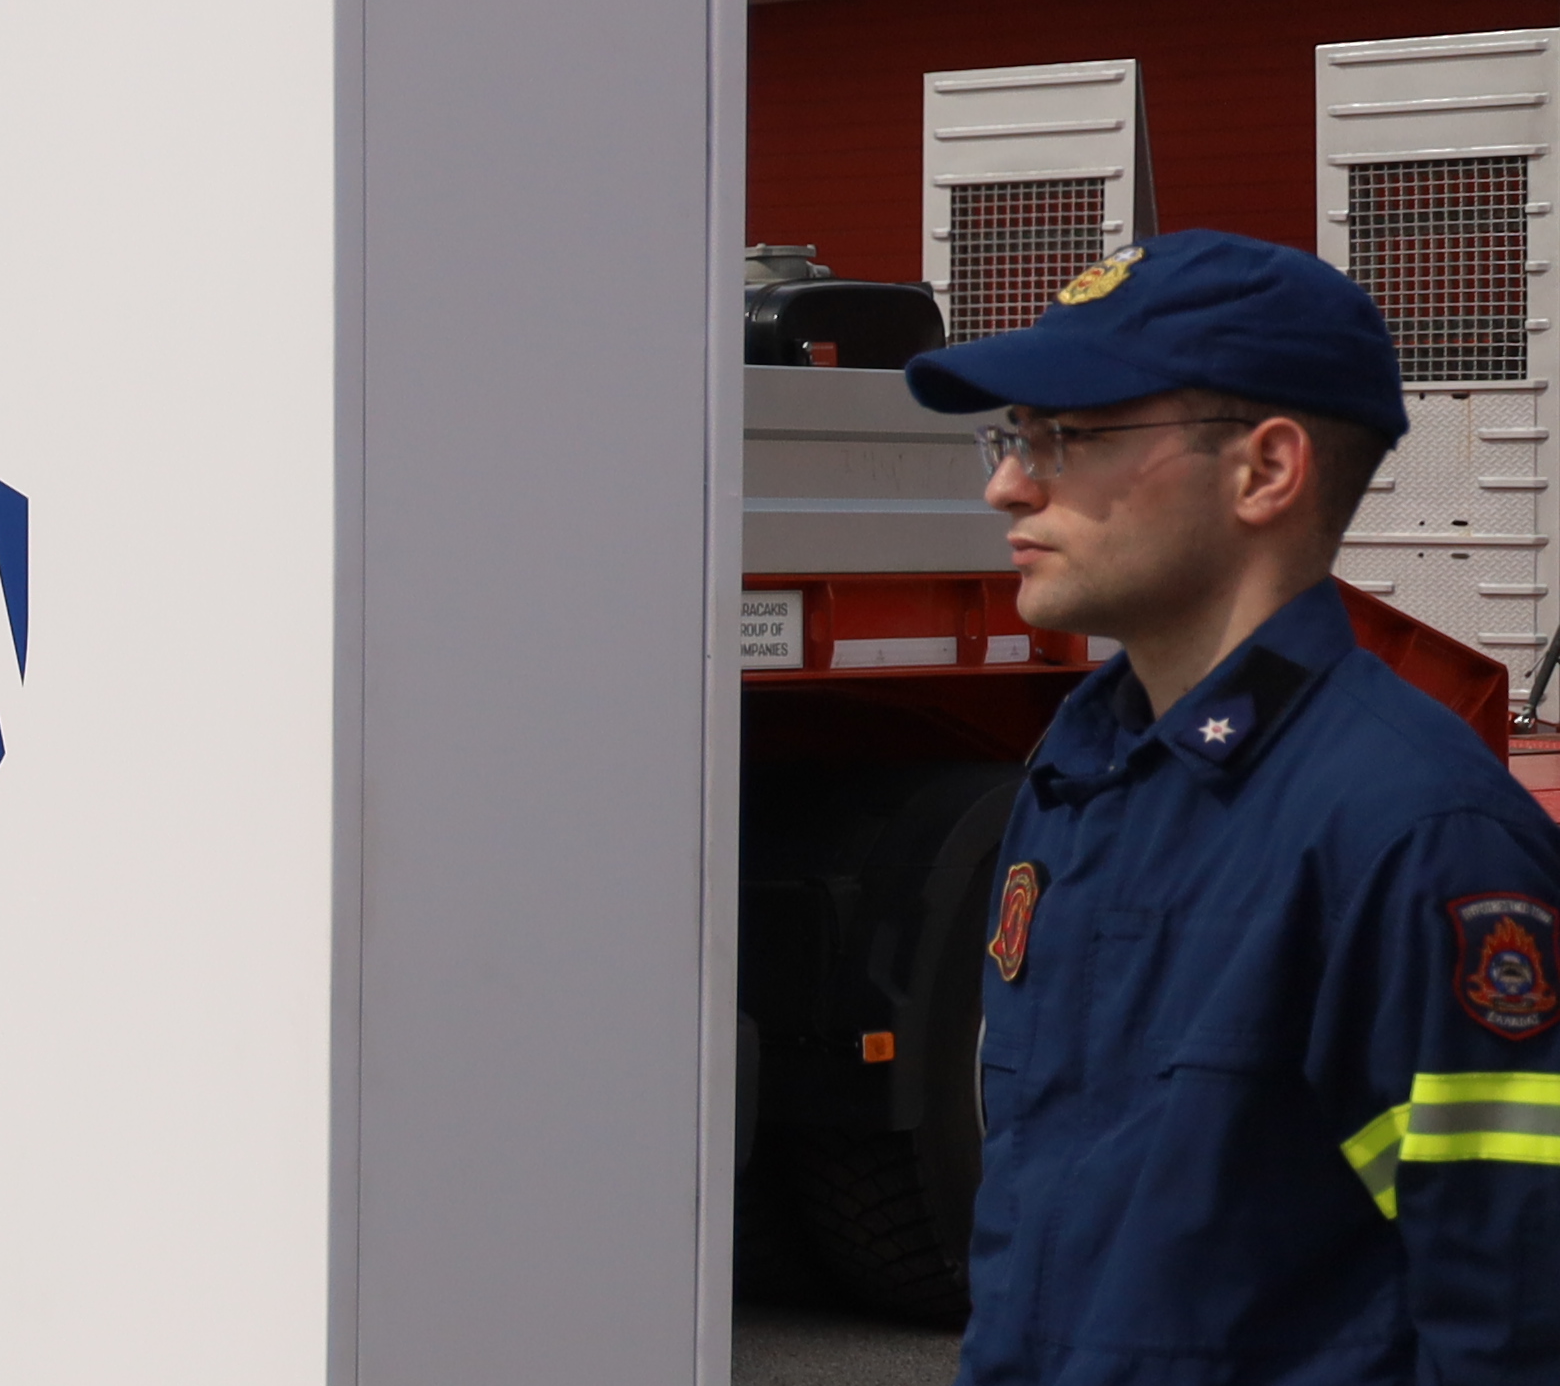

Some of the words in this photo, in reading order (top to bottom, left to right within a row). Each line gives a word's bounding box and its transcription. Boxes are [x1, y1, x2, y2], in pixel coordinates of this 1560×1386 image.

[741, 602, 788, 616] RACAKIS
[741, 623, 768, 637] ROUP
[771, 623, 784, 636] OF
[741, 643, 788, 656] MPANIES
